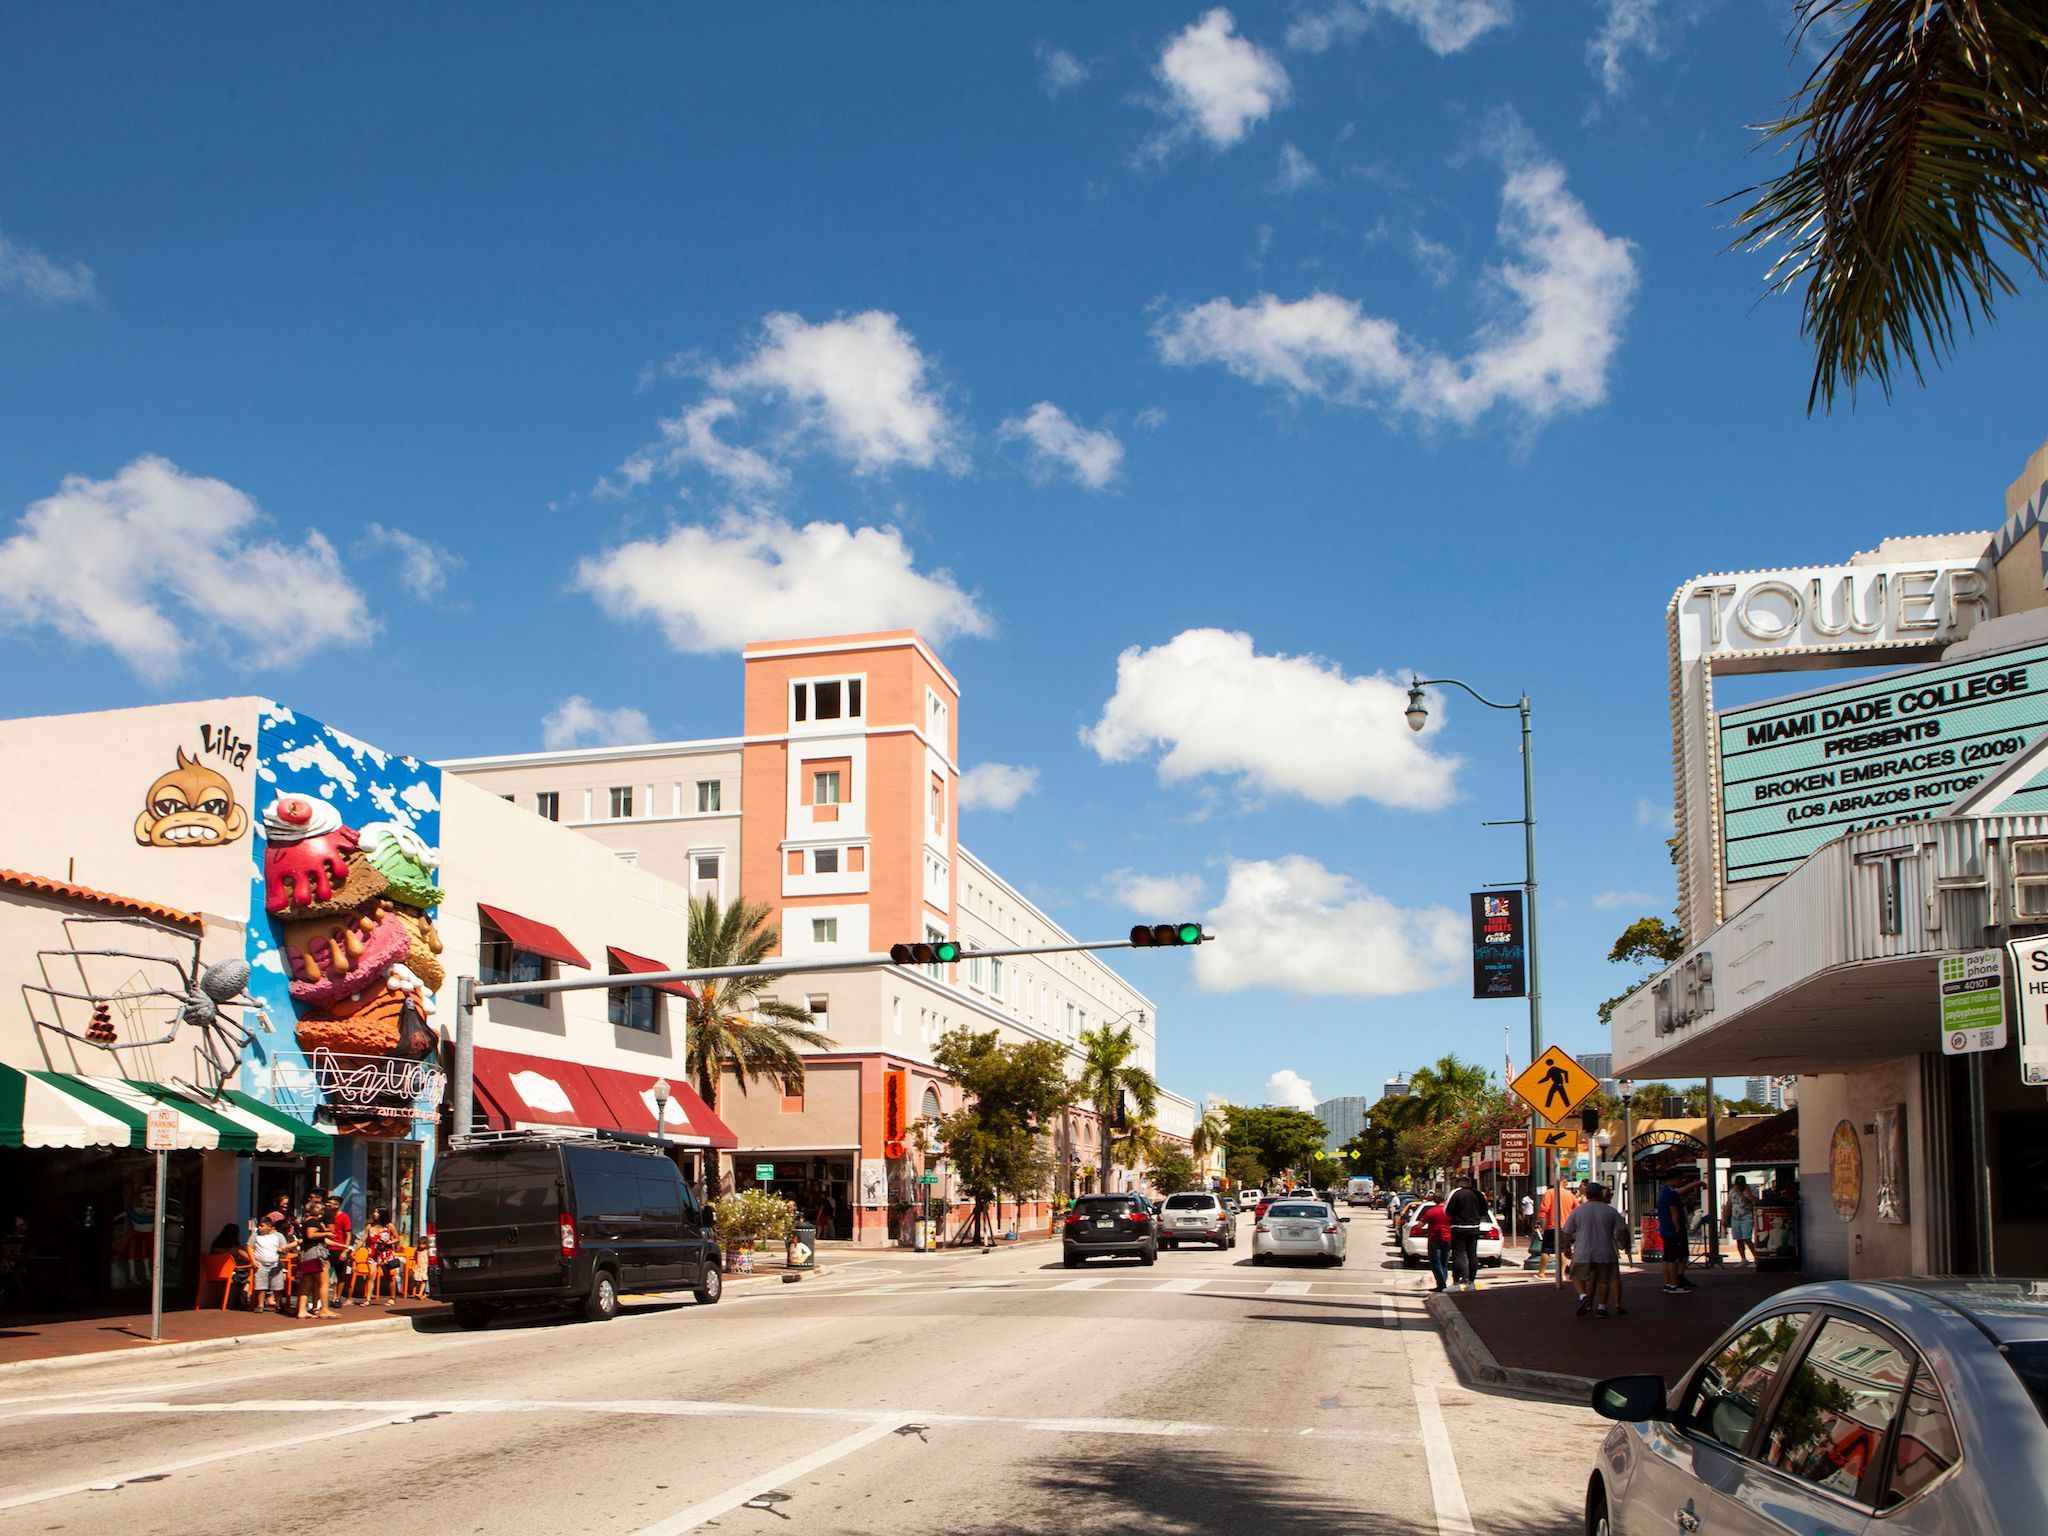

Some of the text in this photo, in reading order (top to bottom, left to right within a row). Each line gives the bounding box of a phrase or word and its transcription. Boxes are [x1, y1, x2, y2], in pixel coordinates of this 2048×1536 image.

[1692, 568, 1991, 645] TOWER
[1746, 668, 2029, 747] MIAMI DADE COLLEGE
[1824, 719, 1941, 758] PRESENTS
[1755, 735, 2026, 801] BROKEN EMBRACES (2009)
[1786, 802, 1825, 824] (LOS
[1828, 786, 1911, 815] ABRAZOS
[1964, 979, 1988, 991] 40101
[1967, 965, 1998, 977] phone
[1945, 1005, 2001, 1021] paybyphone.com
